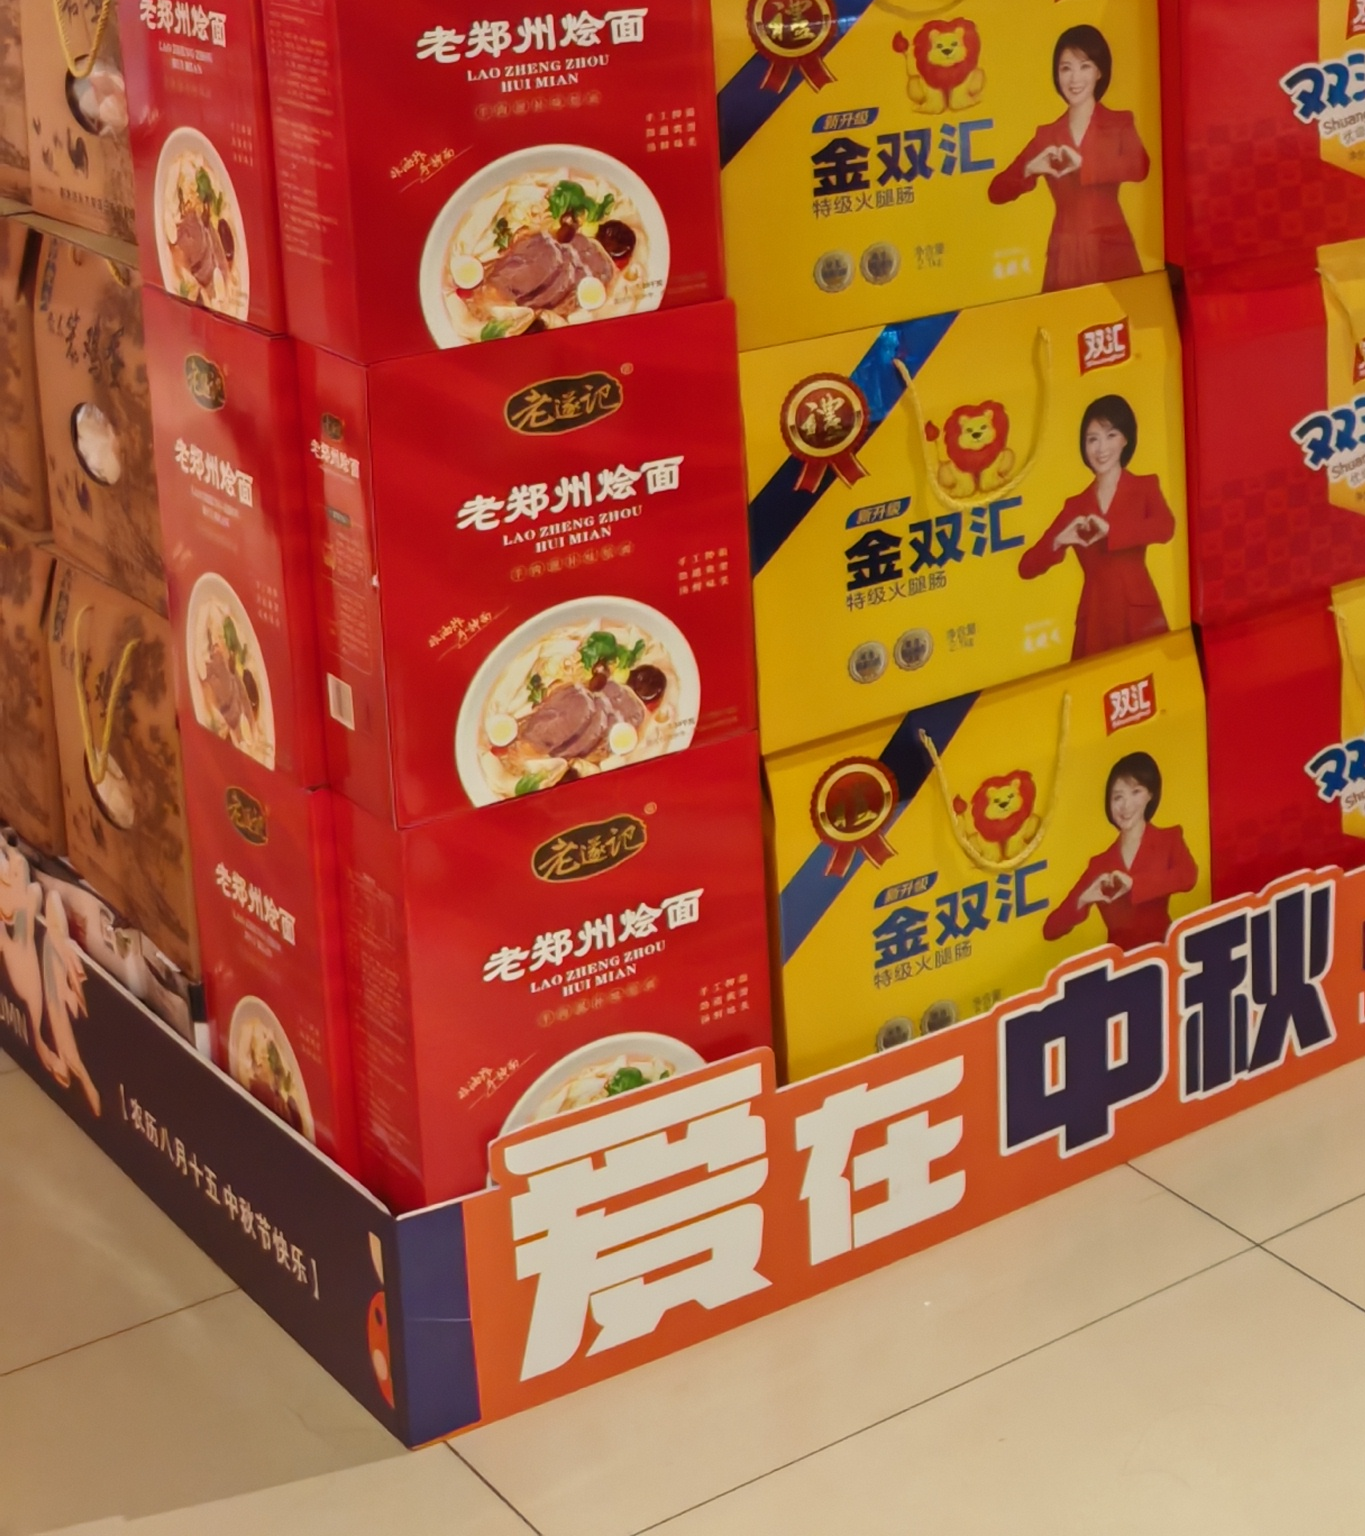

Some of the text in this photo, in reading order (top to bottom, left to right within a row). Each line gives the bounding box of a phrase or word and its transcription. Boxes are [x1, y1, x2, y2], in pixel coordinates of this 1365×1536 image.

[416, 7, 648, 64] 老郑州烩面
[466, 53, 612, 84] LAO ZHENG ZHOU
[500, 72, 580, 94] HUI MIAN
[810, 118, 996, 198] 金双汇
[811, 185, 916, 220] 特级火腿肠
[1083, 323, 1125, 361] 双汇
[456, 455, 685, 532] 老郑州烩面
[502, 504, 645, 548] LAO ZHENG ZHOU
[534, 525, 613, 554] HUI MIAN
[844, 495, 1026, 592] 金双汇
[845, 570, 948, 612] 特级火腿肠
[1108, 678, 1153, 721] 双汇
[482, 887, 704, 984] 老郑州烩面
[873, 859, 1050, 969] 金双汇
[529, 939, 667, 994] LAO ZHENG ZHOU
[561, 963, 638, 998] HUI MIAN
[872, 940, 973, 990] 特级火腿肠
[503, 877, 1338, 1383] 爱在中秋
